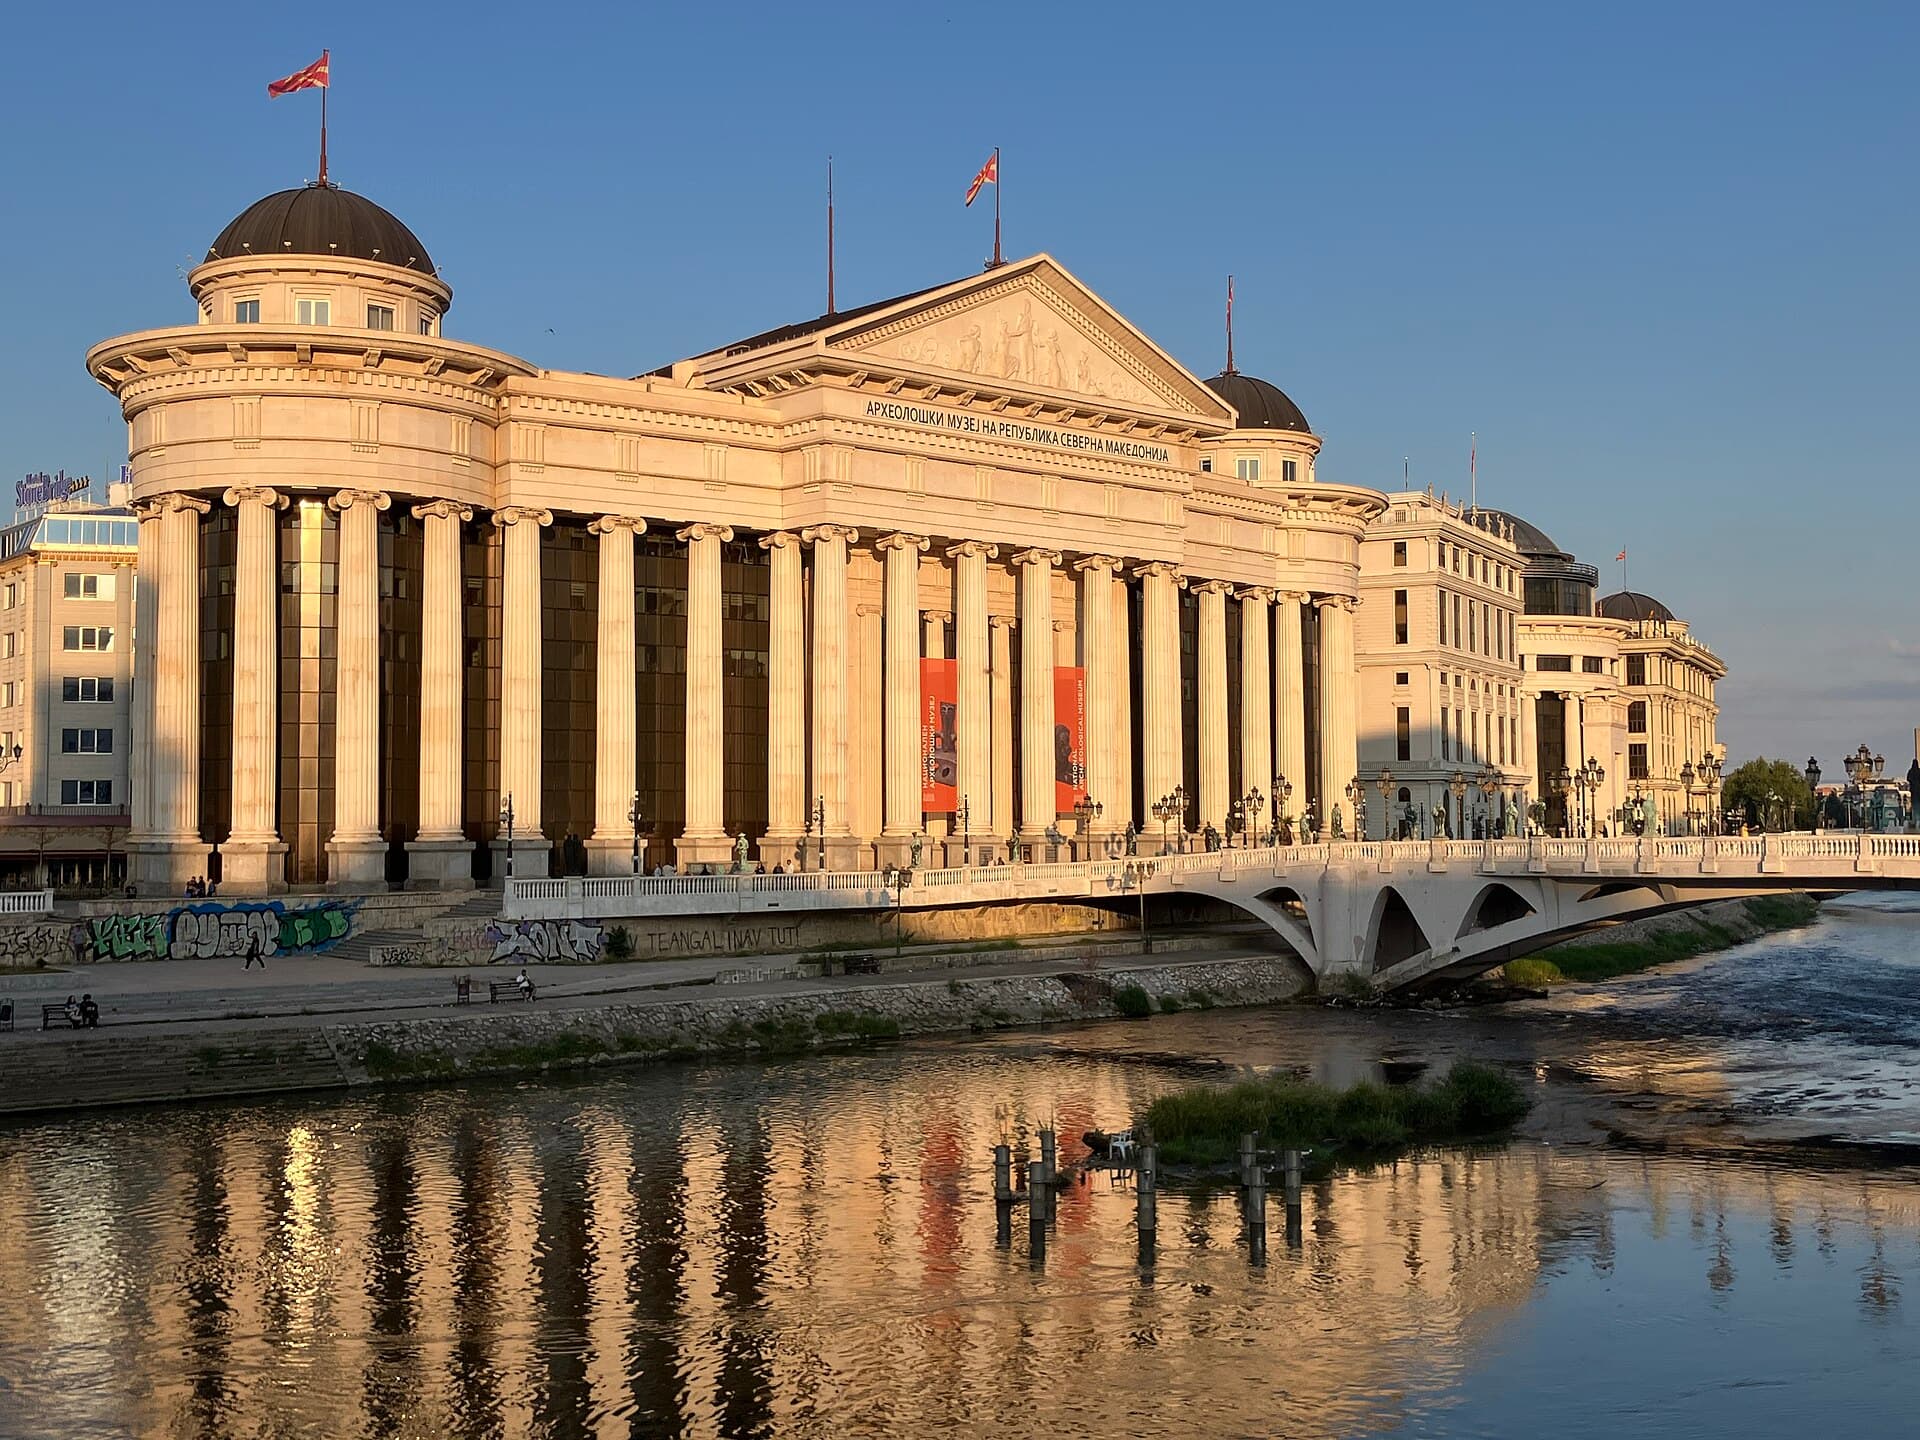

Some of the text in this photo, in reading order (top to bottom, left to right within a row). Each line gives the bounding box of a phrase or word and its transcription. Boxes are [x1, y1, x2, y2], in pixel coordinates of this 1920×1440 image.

[866, 400, 1170, 462] АРХЕОЛОШКИ МУЗЕЈ НА РЕПУБЛИКА СЕВЕРНА МАКЕДОНИЈА
[928, 725, 936, 789] АРХЕОЛОШКИ
[1077, 714, 1085, 791] ARCHAEOLOGICAL
